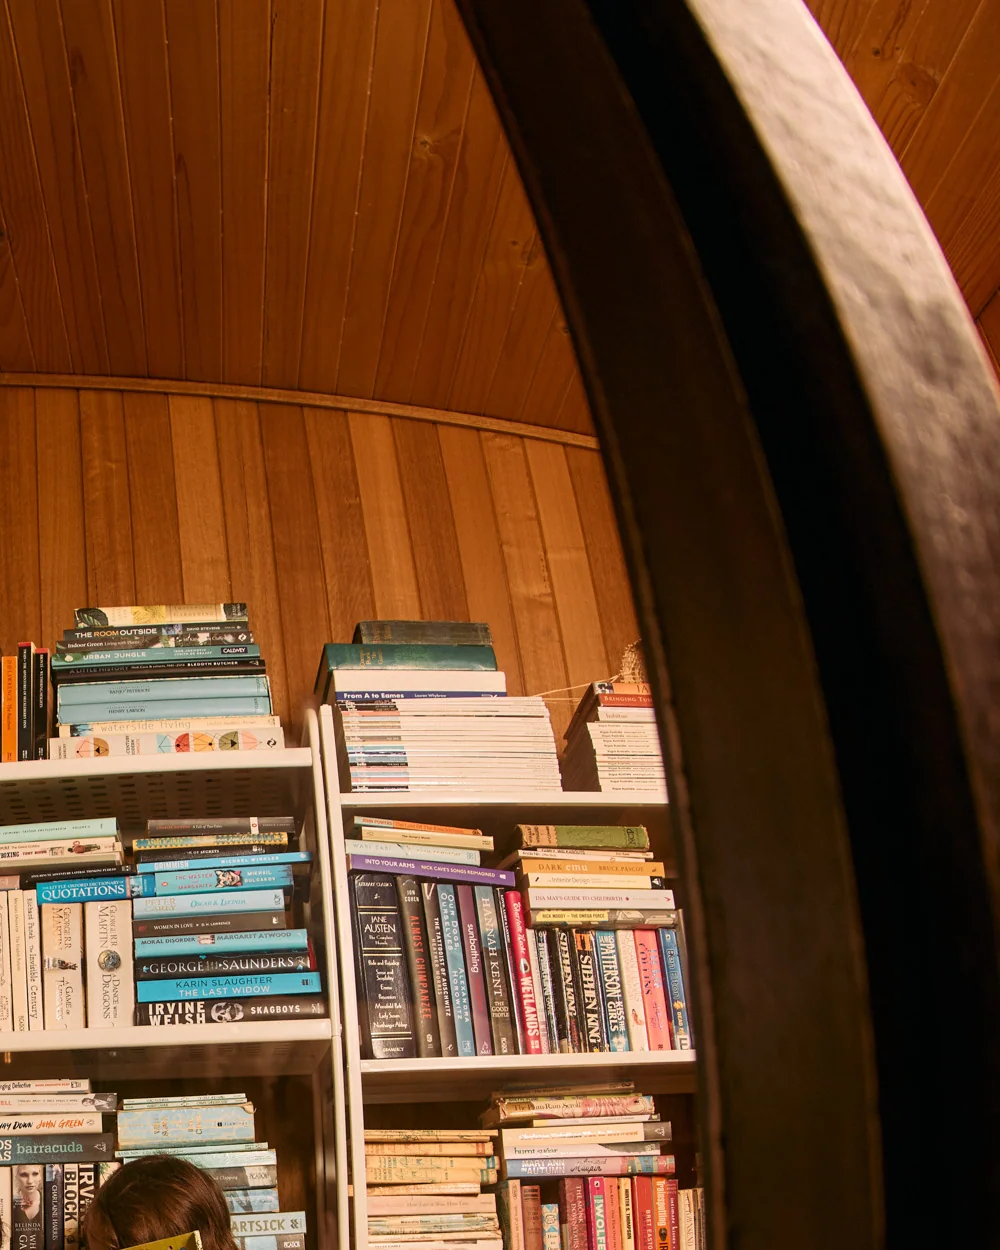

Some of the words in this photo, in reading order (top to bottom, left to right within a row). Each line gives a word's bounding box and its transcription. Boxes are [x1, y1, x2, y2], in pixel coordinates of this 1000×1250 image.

[93, 629, 119, 637] ROOM
[119, 628, 157, 636] OUTSIDE
[604, 695, 637, 703] BRINGING
[100, 719, 154, 732] waterside
[160, 717, 191, 730] living
[538, 863, 562, 871] DARK
[566, 864, 588, 872] emu
[41, 884, 125, 901] QUOTATIONS
[370, 916, 388, 924] JANE
[216, 933, 257, 941] MARGARET
[259, 931, 292, 939] ATWOOD
[364, 924, 397, 934] AUSTEN
[409, 915, 424, 955] ALMOST
[466, 923, 481, 974] sunbathing
[481, 897, 498, 957] HANNAH
[490, 961, 504, 997] KENT
[149, 960, 205, 974] GEORGE
[221, 956, 295, 971] SAUNDERS
[600, 943, 622, 998] PATTERSON
[175, 980, 208, 989] KARIN
[211, 976, 273, 987] SLAUGHTER
[414, 958, 433, 1020] CHIMPANZEE
[579, 954, 598, 1010] STEPHEN
[178, 989, 199, 997] THE
[202, 987, 229, 996] LAST
[231, 985, 272, 995] WIDOW
[452, 970, 463, 1020] HOROWITZ
[458, 966, 471, 1023] ALEXANDRA
[149, 1001, 206, 1015] IRVINE
[250, 1004, 301, 1014] SKAGBOYS
[520, 976, 541, 1037] WETLANDS
[149, 1013, 207, 1026] WELSH
[607, 1001, 619, 1032] GIRLS
[586, 1012, 601, 1044] KING
[36, 1119, 56, 1130] JOHN
[58, 1118, 84, 1128] GREEN
[16, 1142, 84, 1154] barracuda
[64, 1171, 78, 1222] BLOCK
[656, 1179, 667, 1227] Trainspotting
